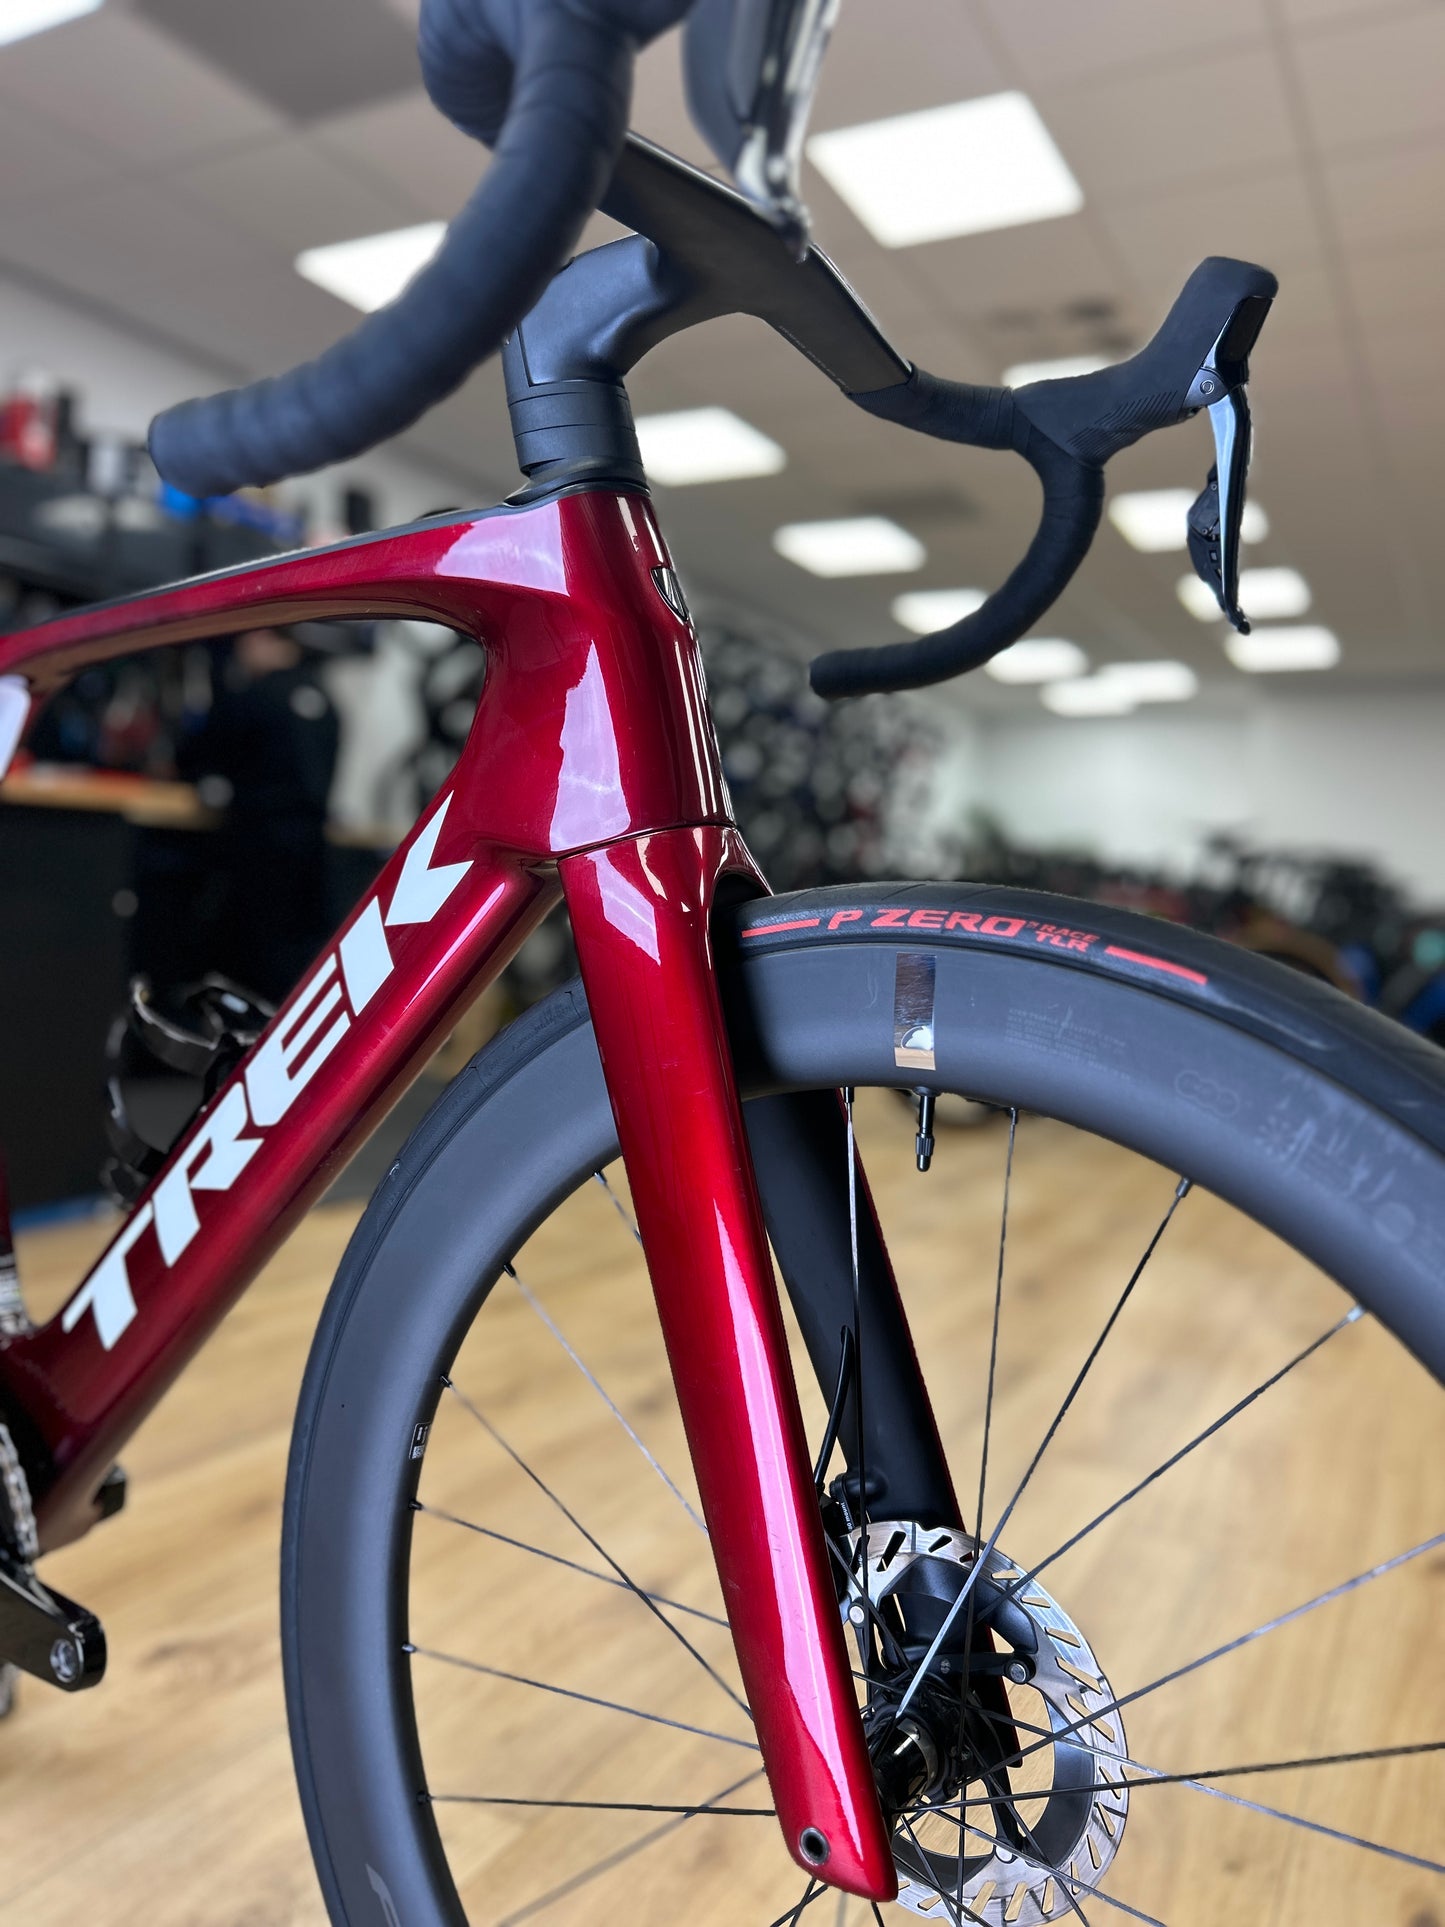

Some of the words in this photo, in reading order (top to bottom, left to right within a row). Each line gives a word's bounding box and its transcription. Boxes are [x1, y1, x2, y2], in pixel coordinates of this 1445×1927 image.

[827, 910, 864, 930] P
[870, 909, 1026, 937] ZERO
[1035, 930, 1089, 953] TLR
[62, 790, 474, 1350] TREK
